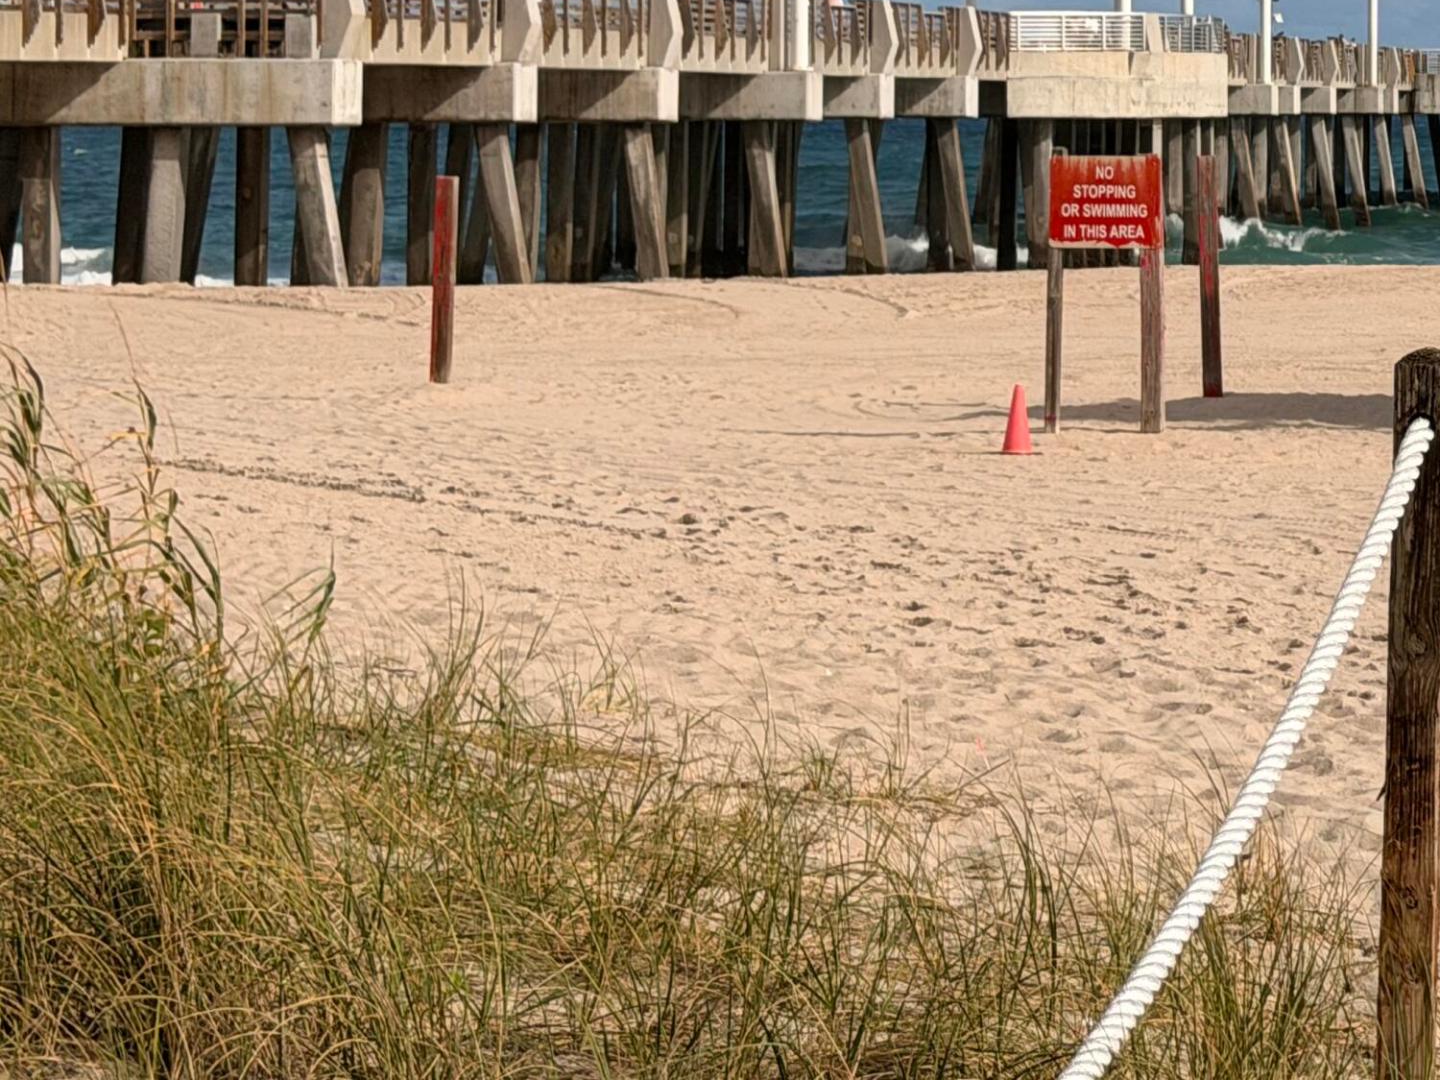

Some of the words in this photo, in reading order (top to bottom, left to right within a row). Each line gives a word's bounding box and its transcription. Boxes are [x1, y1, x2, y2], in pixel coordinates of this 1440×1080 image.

[1095, 166, 1114, 180] NO
[1073, 184, 1136, 199] STOPPING
[1061, 203, 1080, 217] OR
[1082, 203, 1148, 218] SWIMMING
[1063, 224, 1076, 238] IN
[1079, 224, 1107, 238] THIS
[1109, 224, 1145, 238] AREA
